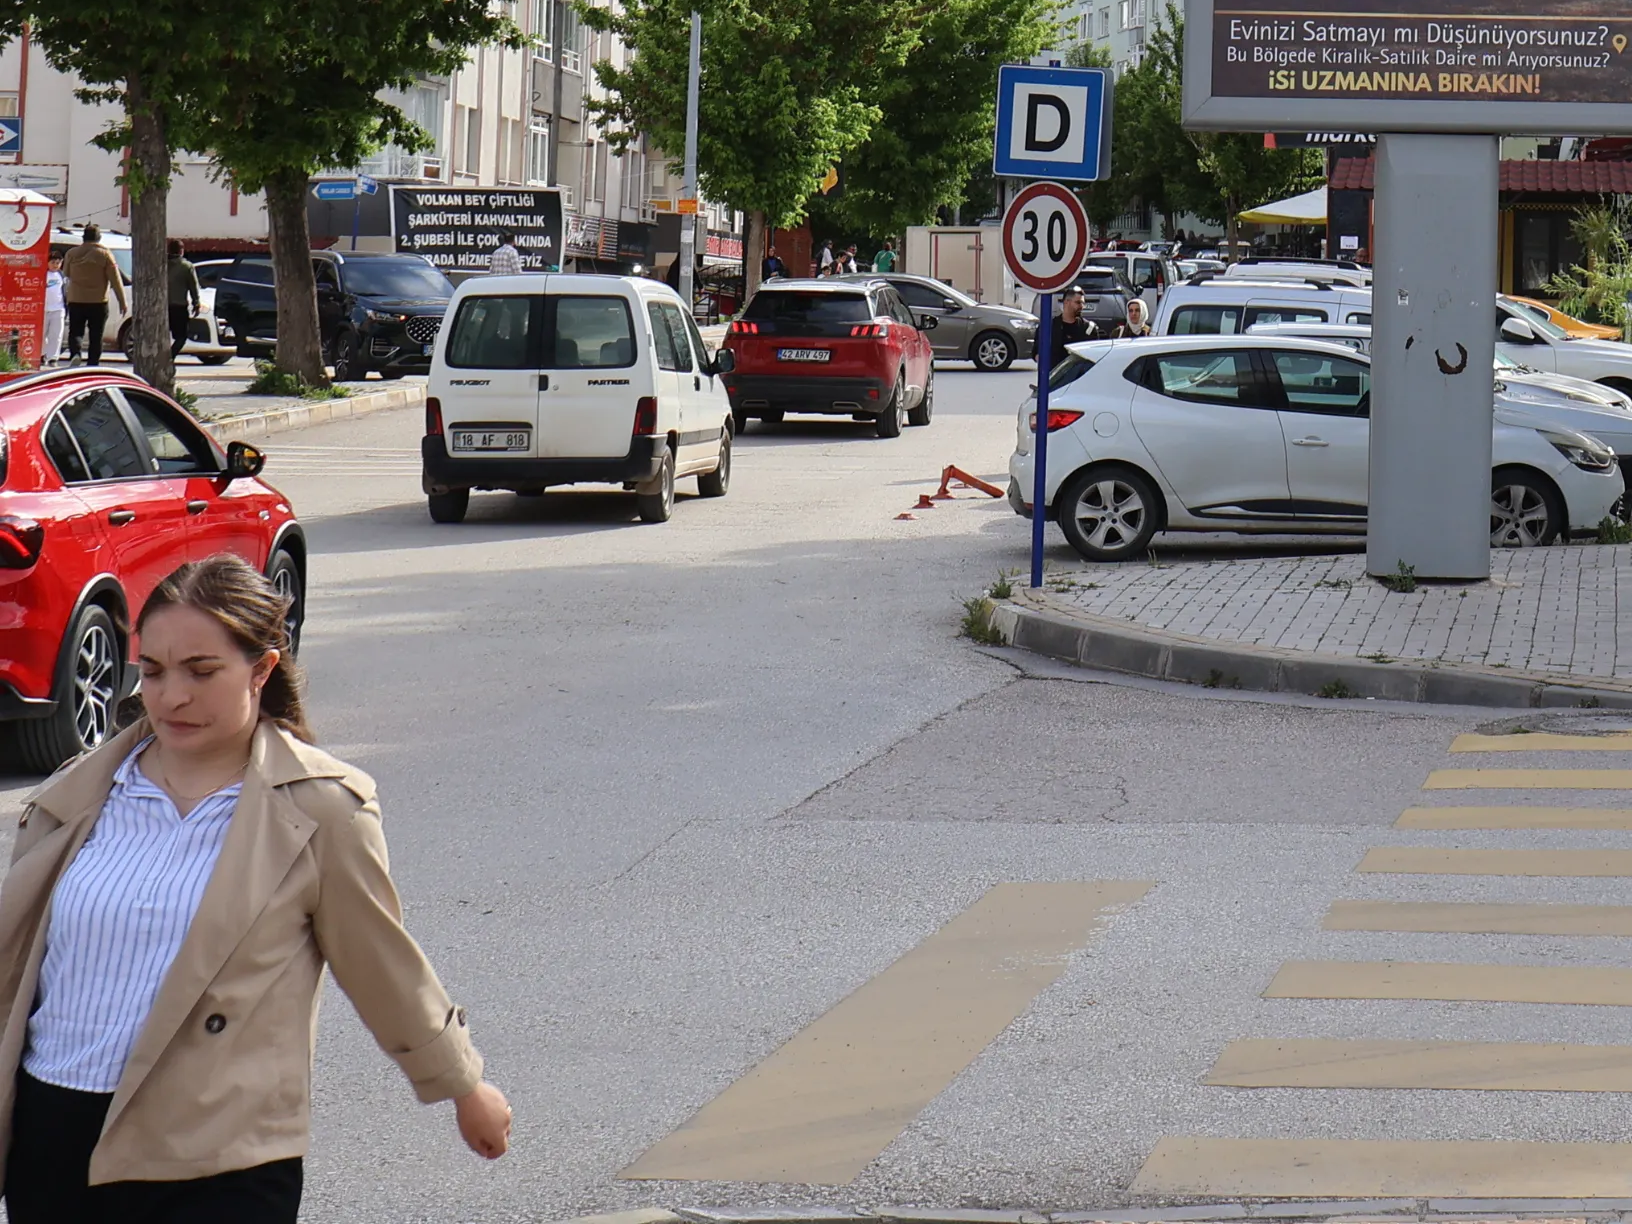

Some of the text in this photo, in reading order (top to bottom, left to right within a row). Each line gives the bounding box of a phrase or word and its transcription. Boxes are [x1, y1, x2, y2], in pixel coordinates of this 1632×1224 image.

[1230, 19, 1610, 50] Evinizi Satmayı mı Düşünüyorsunuz?
[1227, 46, 1611, 71] Bu Bölgede Kiralık-Satılık Daire mi Arıyorsunuz?
[1301, 71, 1433, 93] UZMANINA
[1438, 73, 1542, 95] BIRAKIN!
[1025, 93, 1071, 152] D
[415, 193, 536, 209] VOLKAN BEY ÇİFTLİĞİ
[408, 211, 546, 229] ŞARKÜTERİ KAHVALTILIK
[400, 235, 412, 247] 2.
[413, 231, 455, 250] ŞUBESİ
[457, 230, 474, 247] İLE
[476, 235, 500, 251] ÇOK
[513, 235, 552, 248] KINDA
[1021, 210, 1067, 263] 30
[783, 349, 829, 360] 42 ARV 497
[587, 378, 630, 386] PARTNER
[461, 433, 526, 447] 18 AF 818
